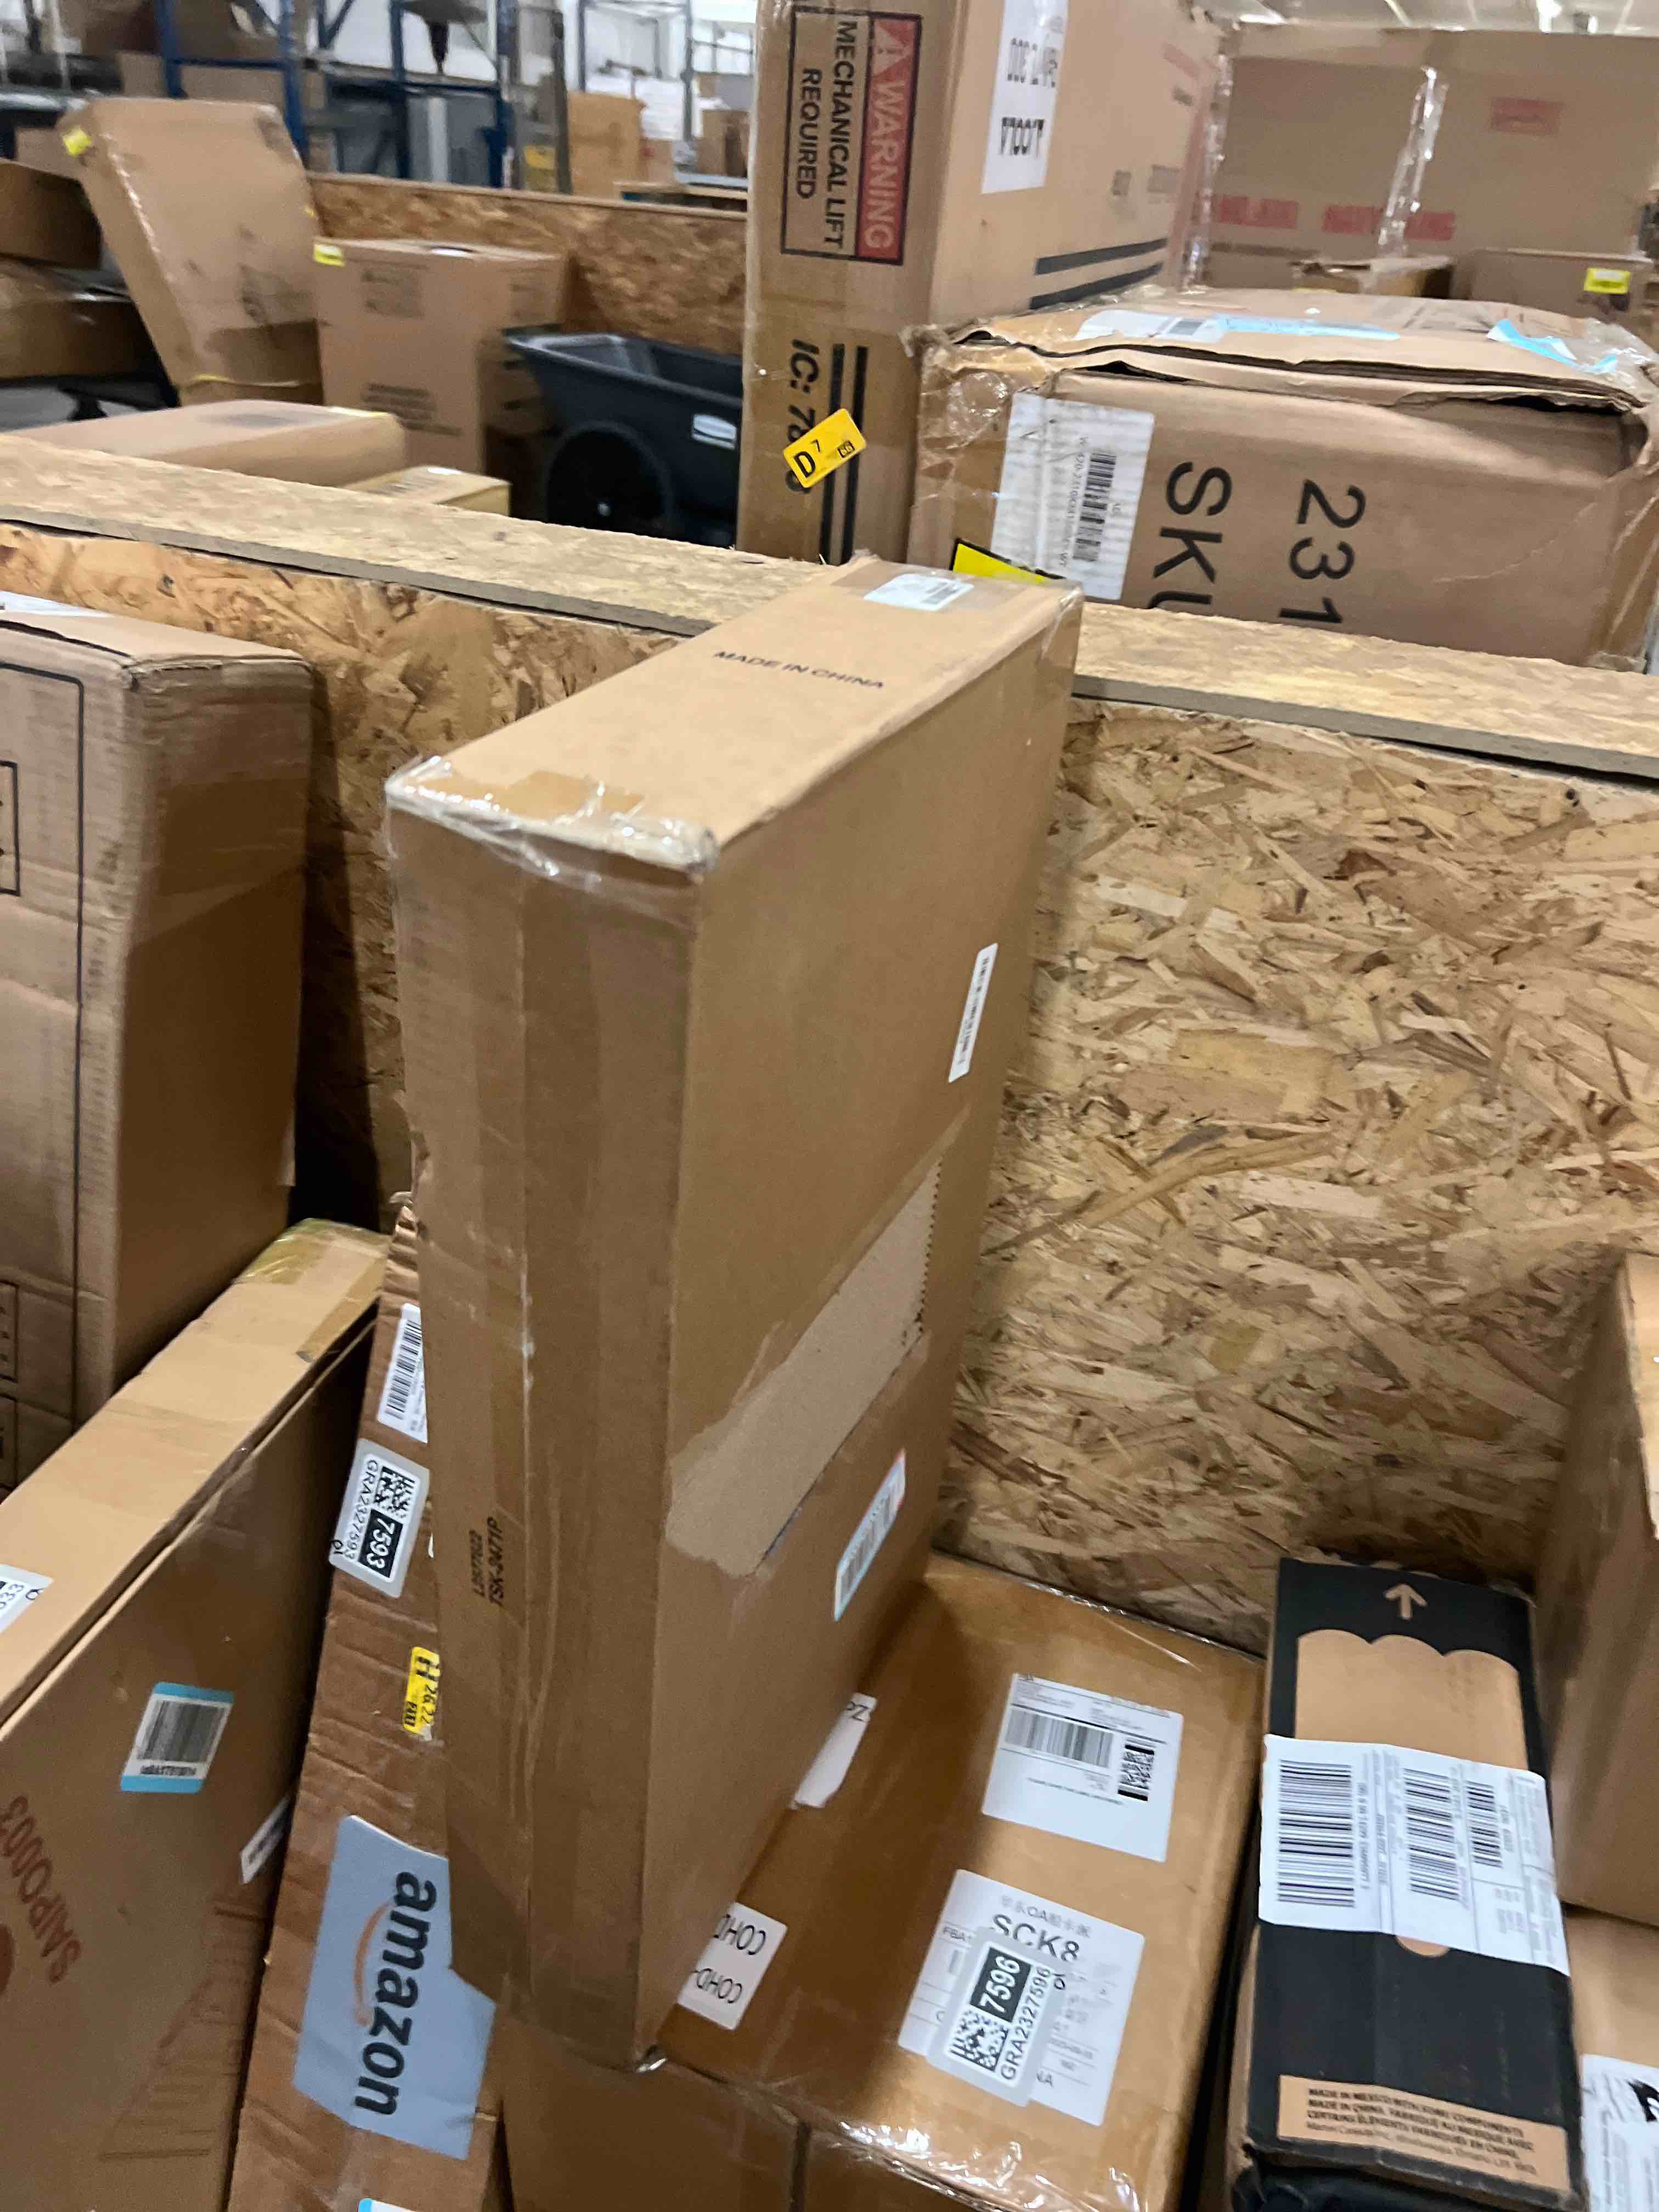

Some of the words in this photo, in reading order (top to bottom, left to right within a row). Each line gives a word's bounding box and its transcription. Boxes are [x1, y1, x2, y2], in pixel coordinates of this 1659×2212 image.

[795, 67, 823, 200] REQUIRED
[826, 21, 857, 193] MECHANICAL
[864, 82, 905, 250] WARNING
[824, 197, 846, 249] LIFT
[793, 451, 816, 478] D
[714, 650, 782, 669] MADE
[783, 663, 809, 674] IN
[811, 668, 885, 689] CHINA
[365, 1517, 396, 1570] 7593
[991, 1912, 1081, 1963] SCK8
[353, 1870, 438, 2117] amazon
[977, 1955, 1022, 2014] 7596
[1000, 1967, 1052, 2081] GRA2327596
